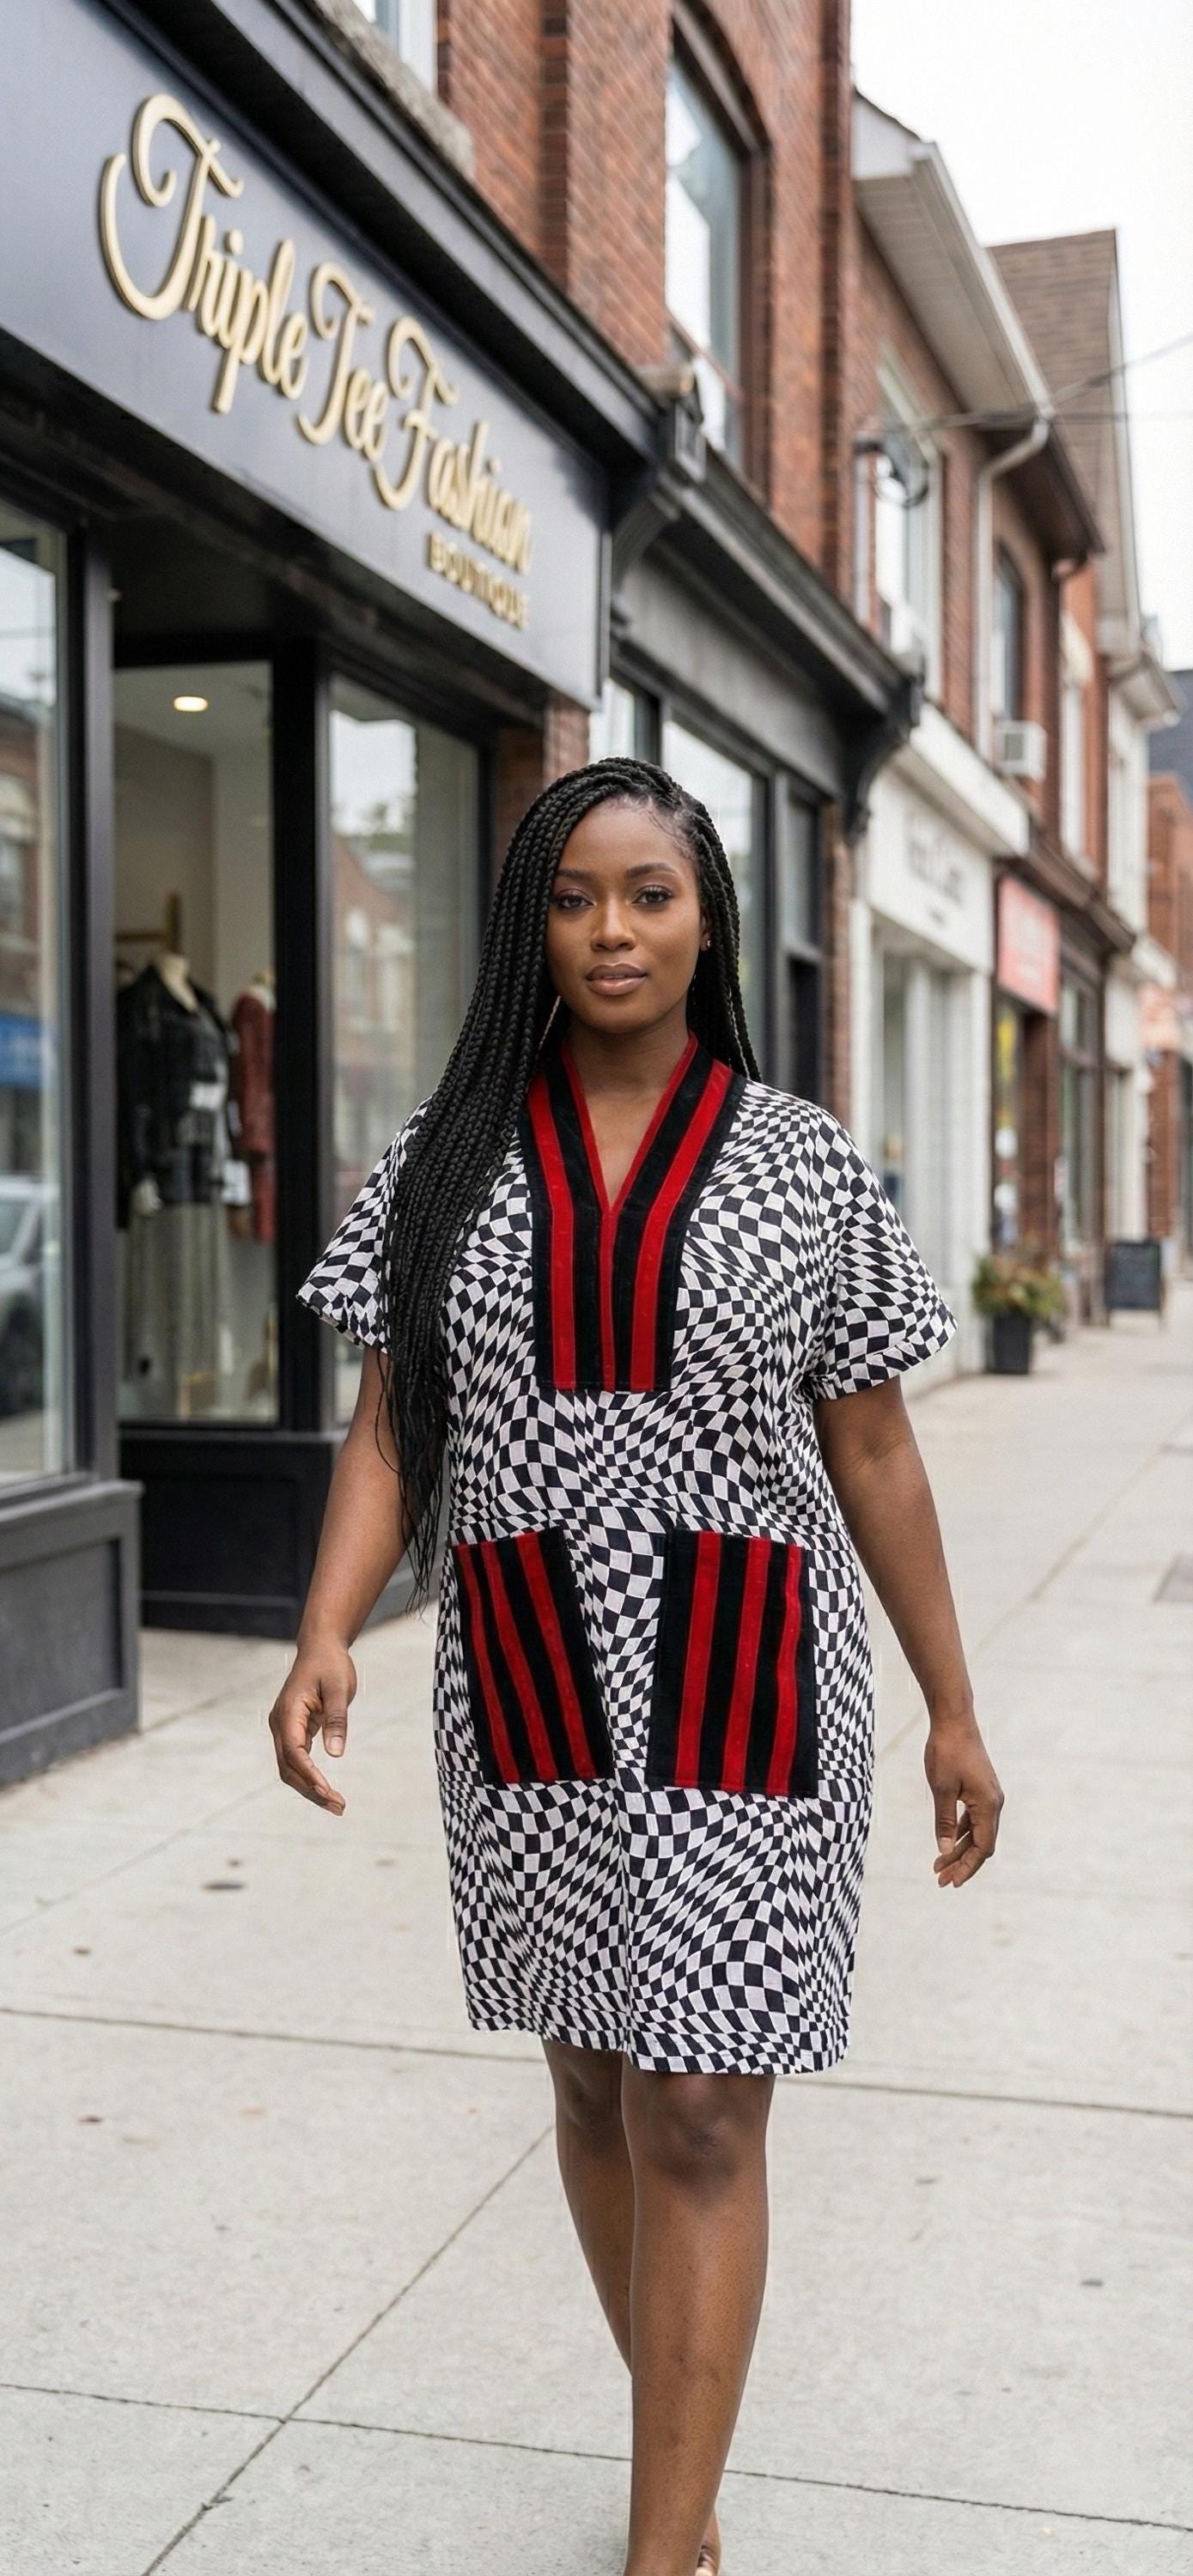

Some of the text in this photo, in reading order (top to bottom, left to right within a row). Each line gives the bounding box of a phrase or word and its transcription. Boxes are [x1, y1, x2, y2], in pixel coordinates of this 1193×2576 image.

[99, 93, 532, 575] Triple Tee Fashion
